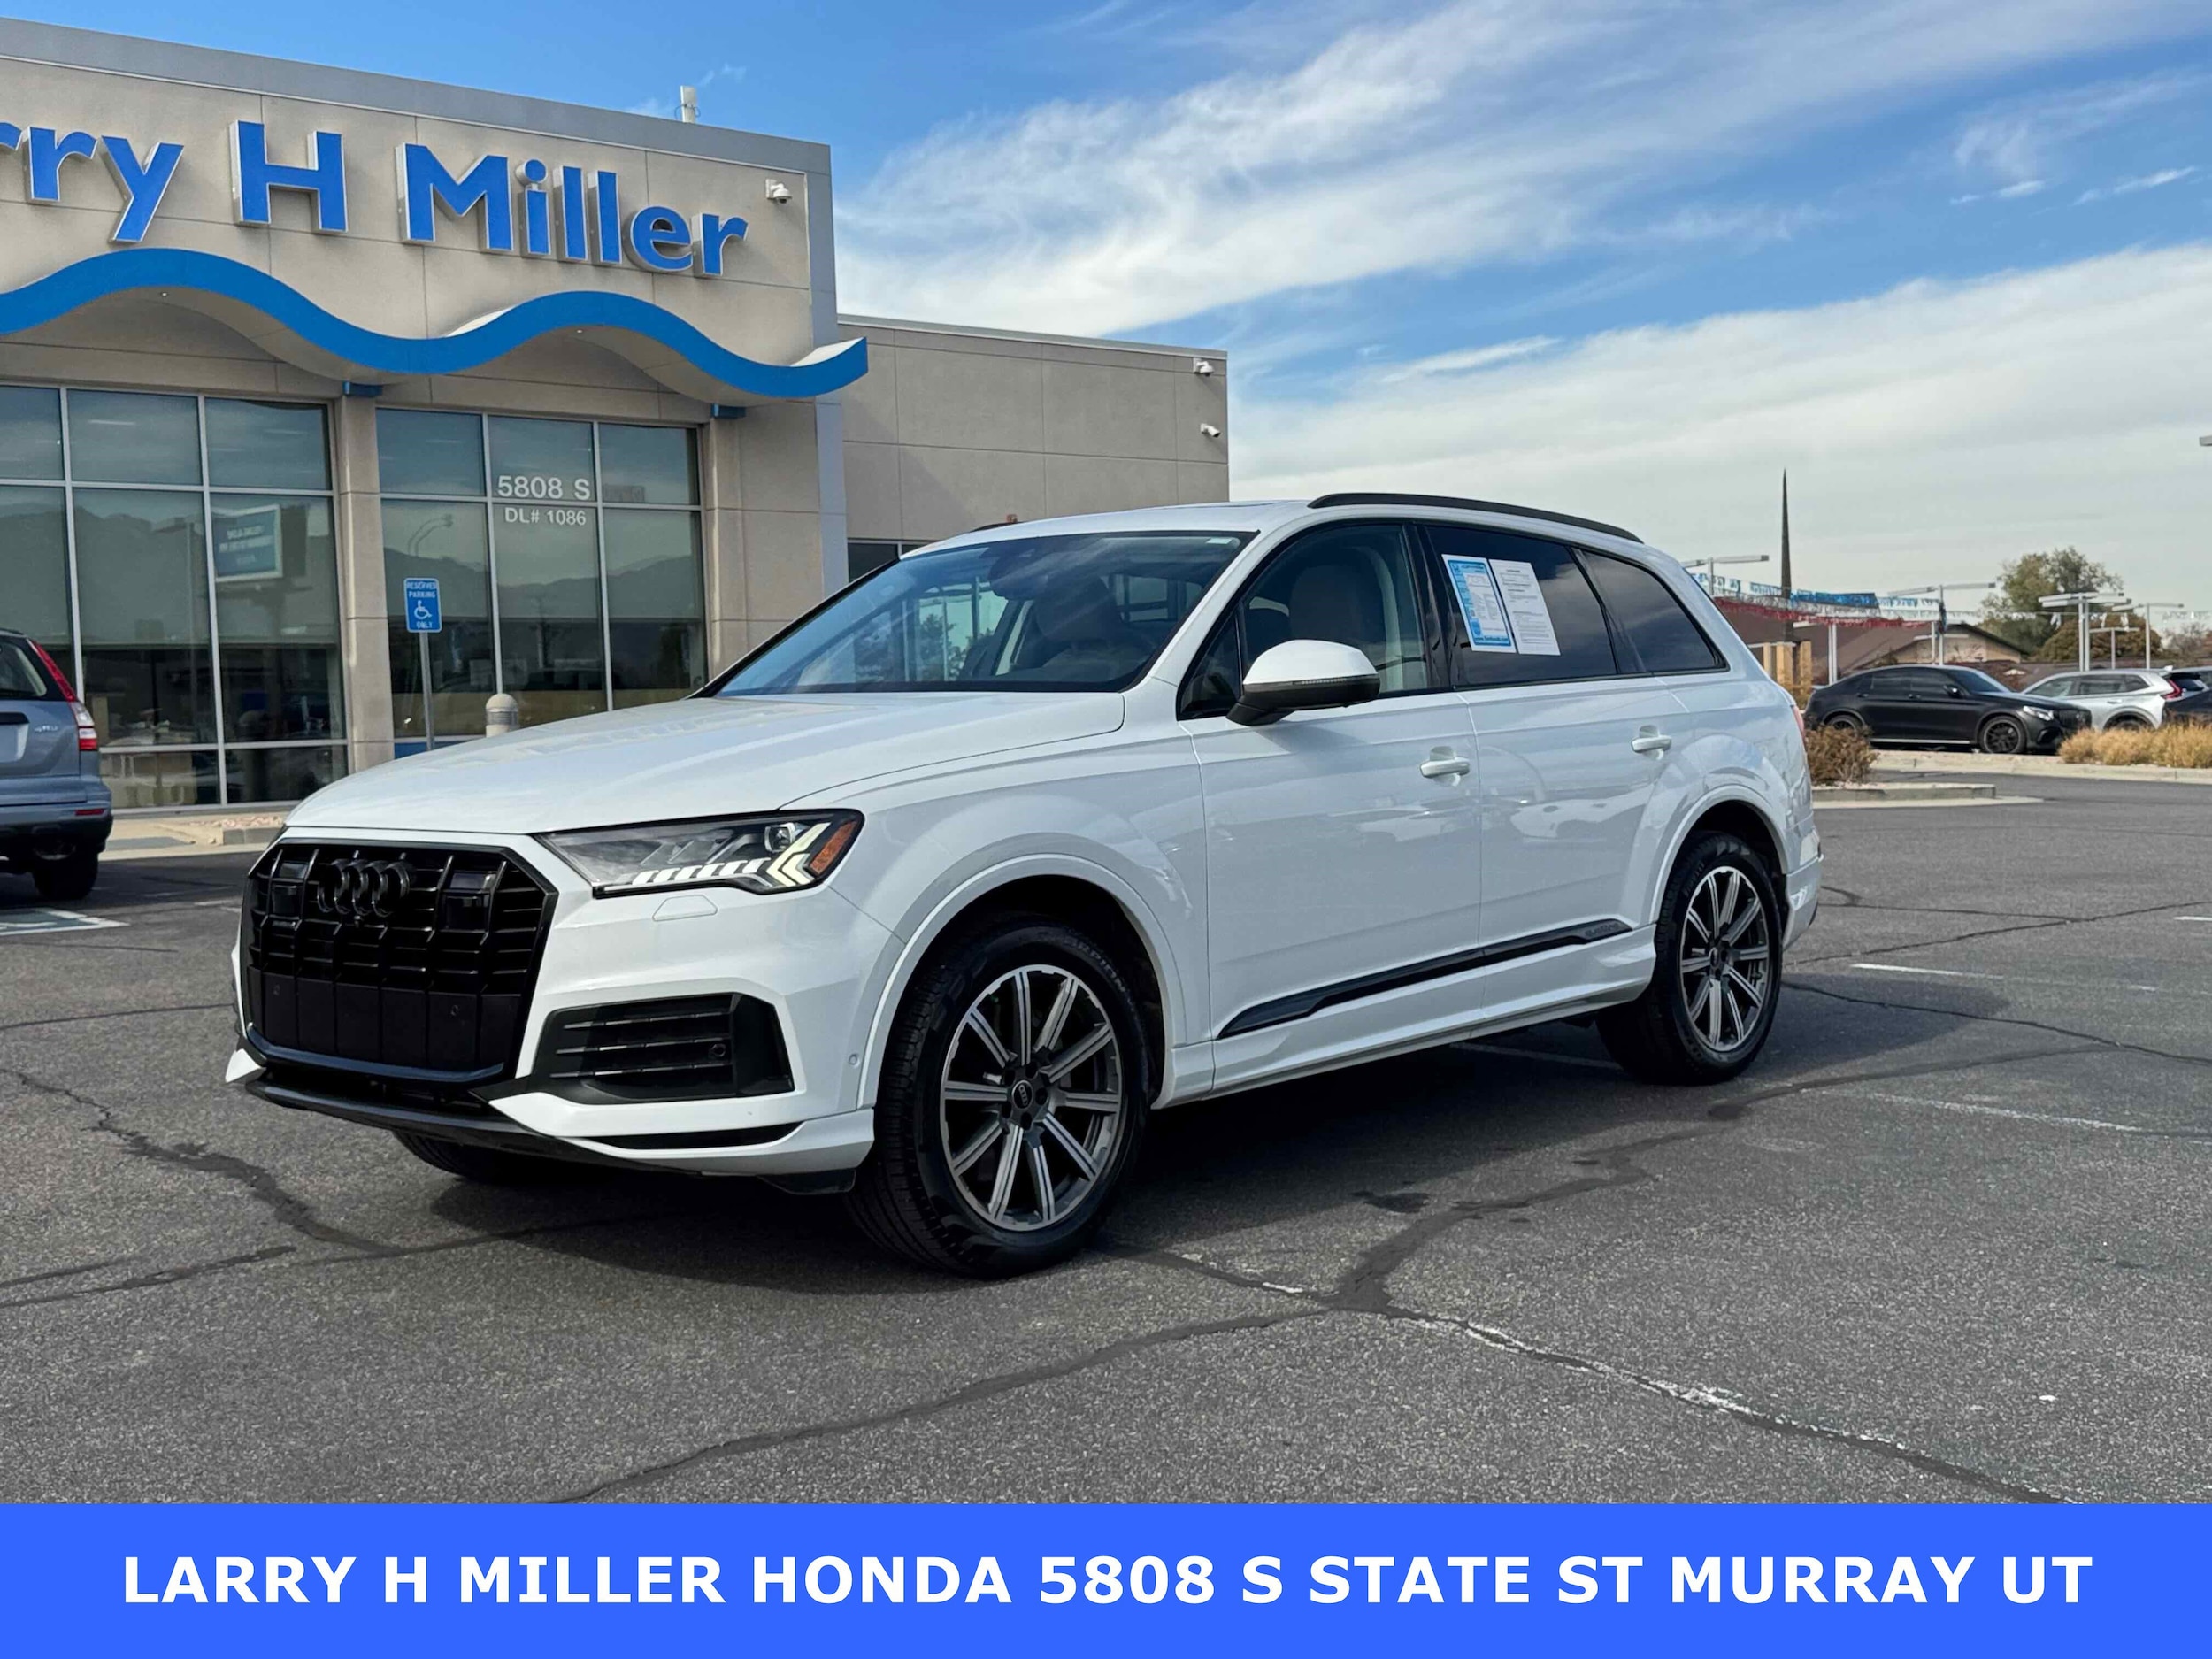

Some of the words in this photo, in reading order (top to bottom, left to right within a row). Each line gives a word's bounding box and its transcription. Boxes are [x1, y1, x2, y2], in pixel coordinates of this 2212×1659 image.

[230, 119, 348, 233] H
[396, 142, 749, 276] Miller
[497, 475, 563, 499] 5808
[574, 478, 590, 501] S
[504, 507, 540, 524] DL#
[547, 509, 587, 526] 1086
